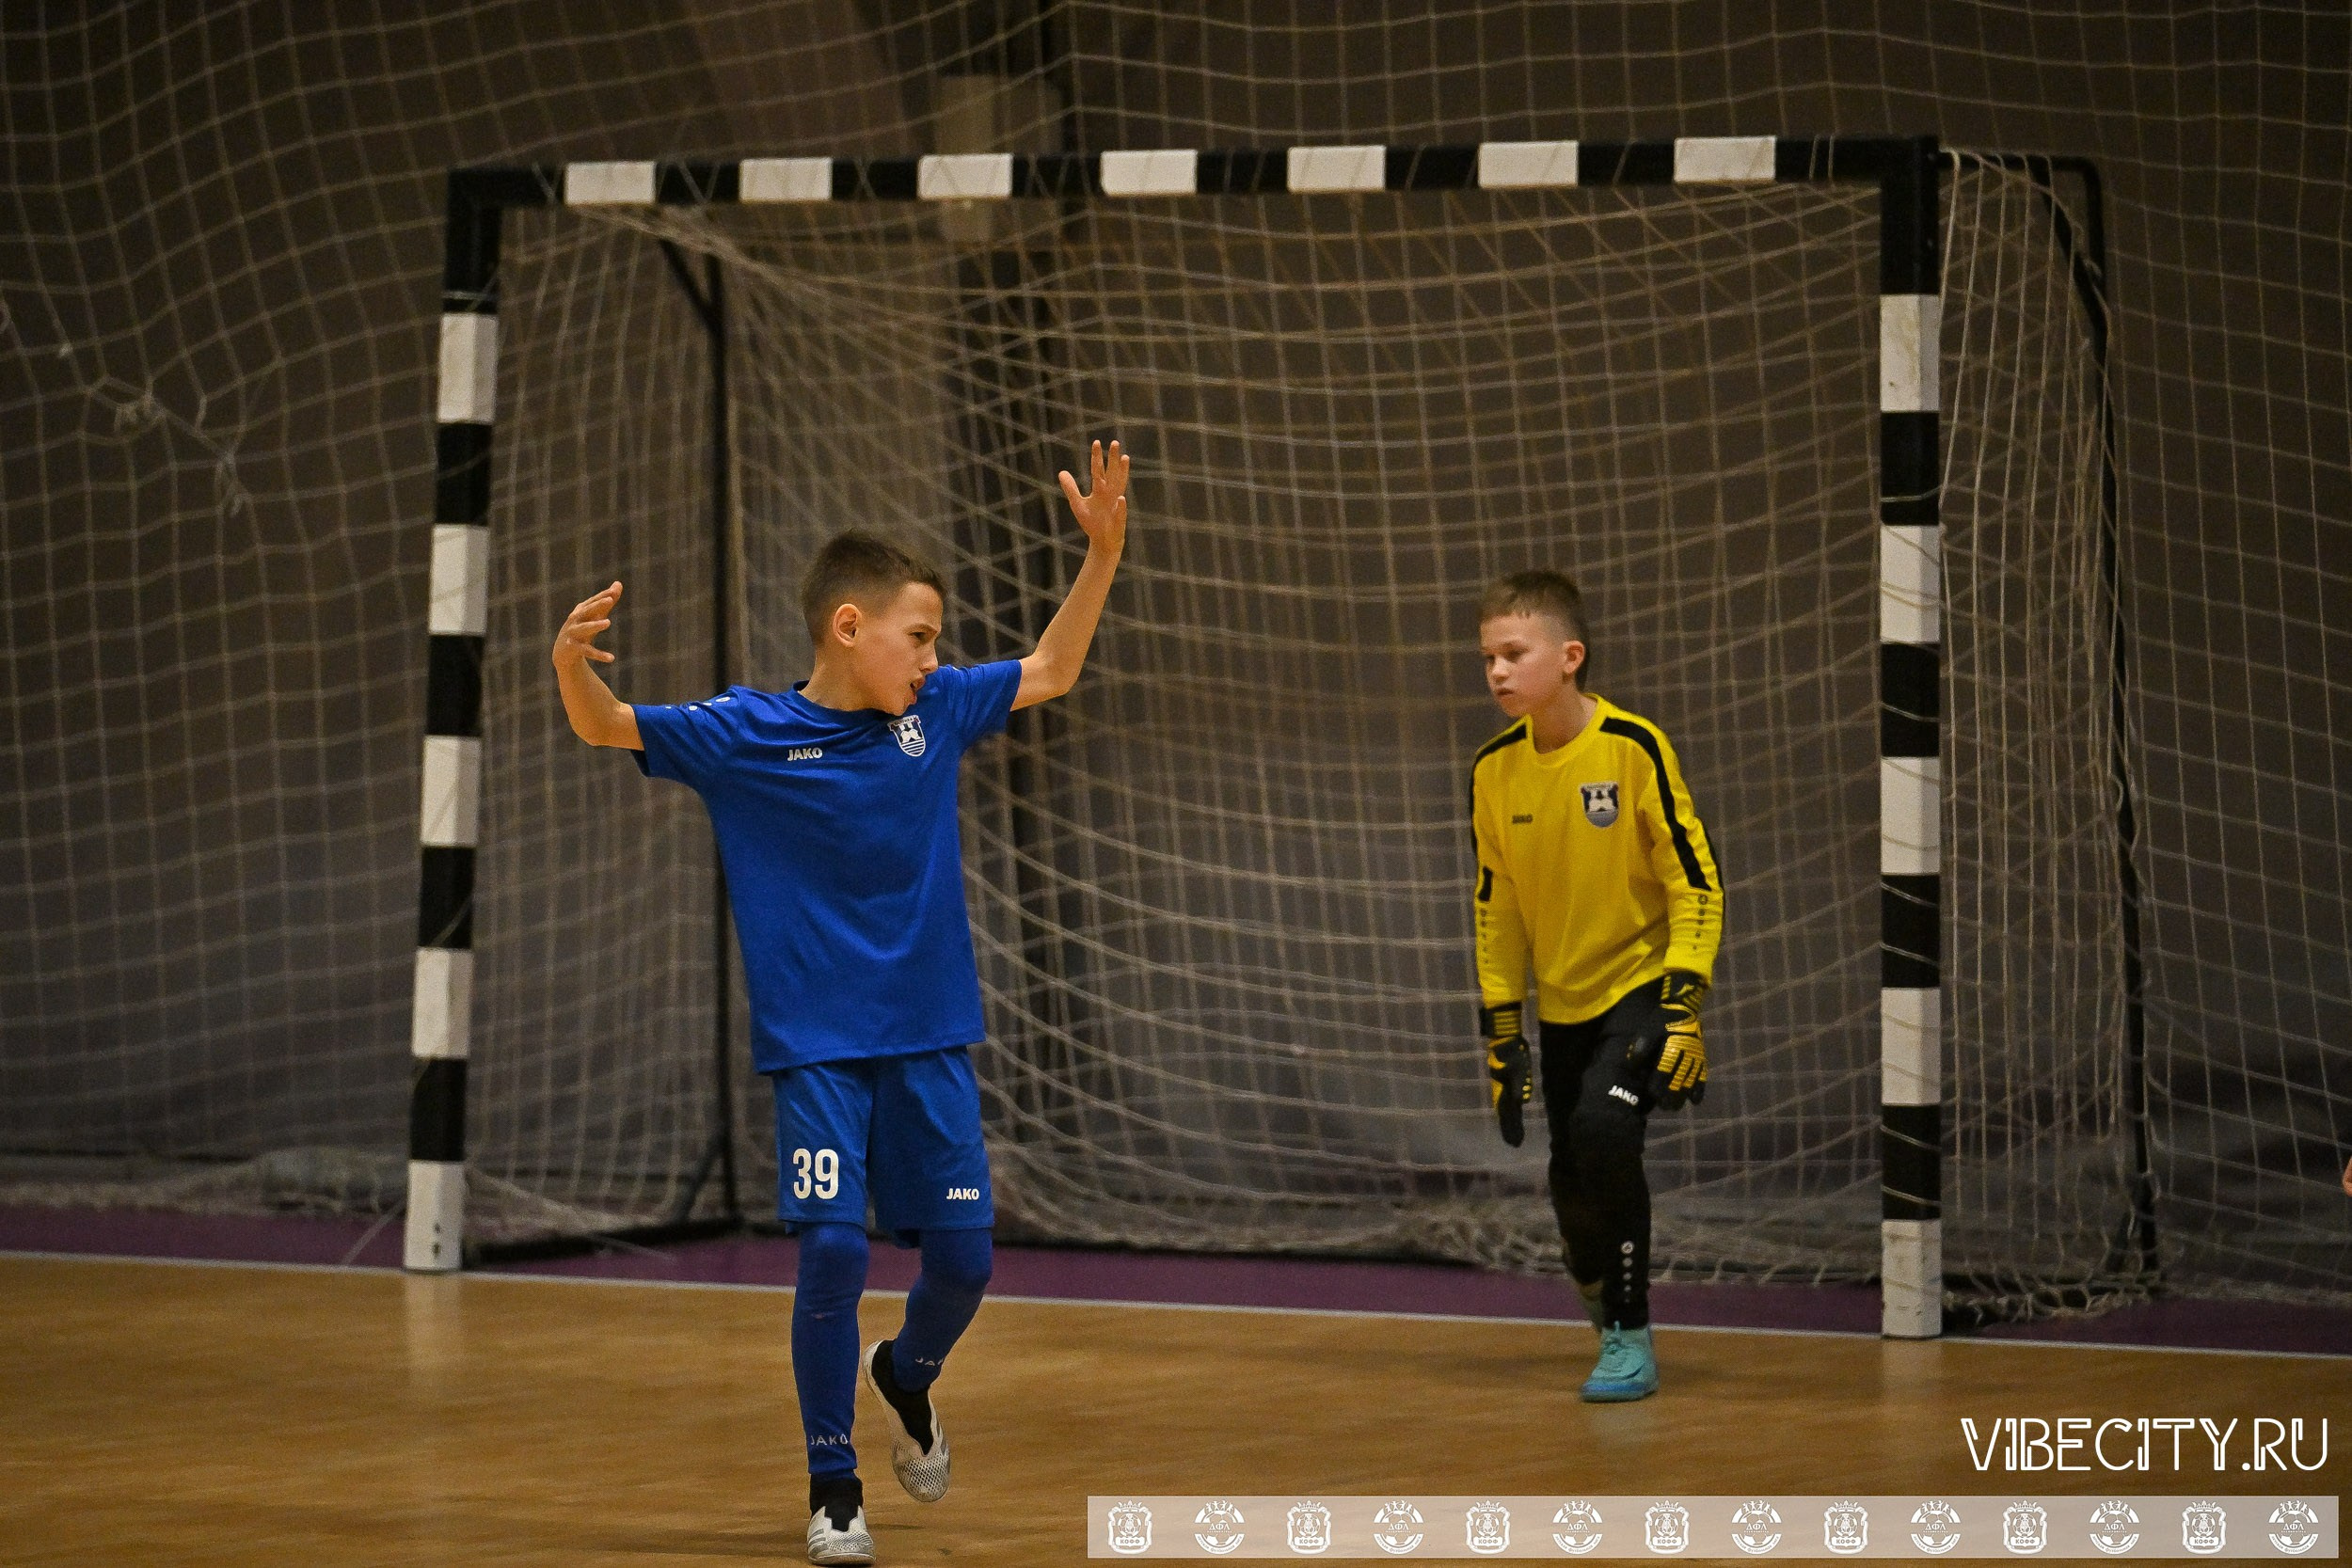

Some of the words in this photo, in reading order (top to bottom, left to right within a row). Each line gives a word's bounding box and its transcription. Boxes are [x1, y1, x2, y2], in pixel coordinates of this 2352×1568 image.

[787, 747, 823, 762] JAKO
[1608, 1085, 1640, 1106] JAKO
[792, 1148, 839, 1200] 39
[946, 1187, 980, 1201] JAKO
[810, 1433, 849, 1446] JAKO
